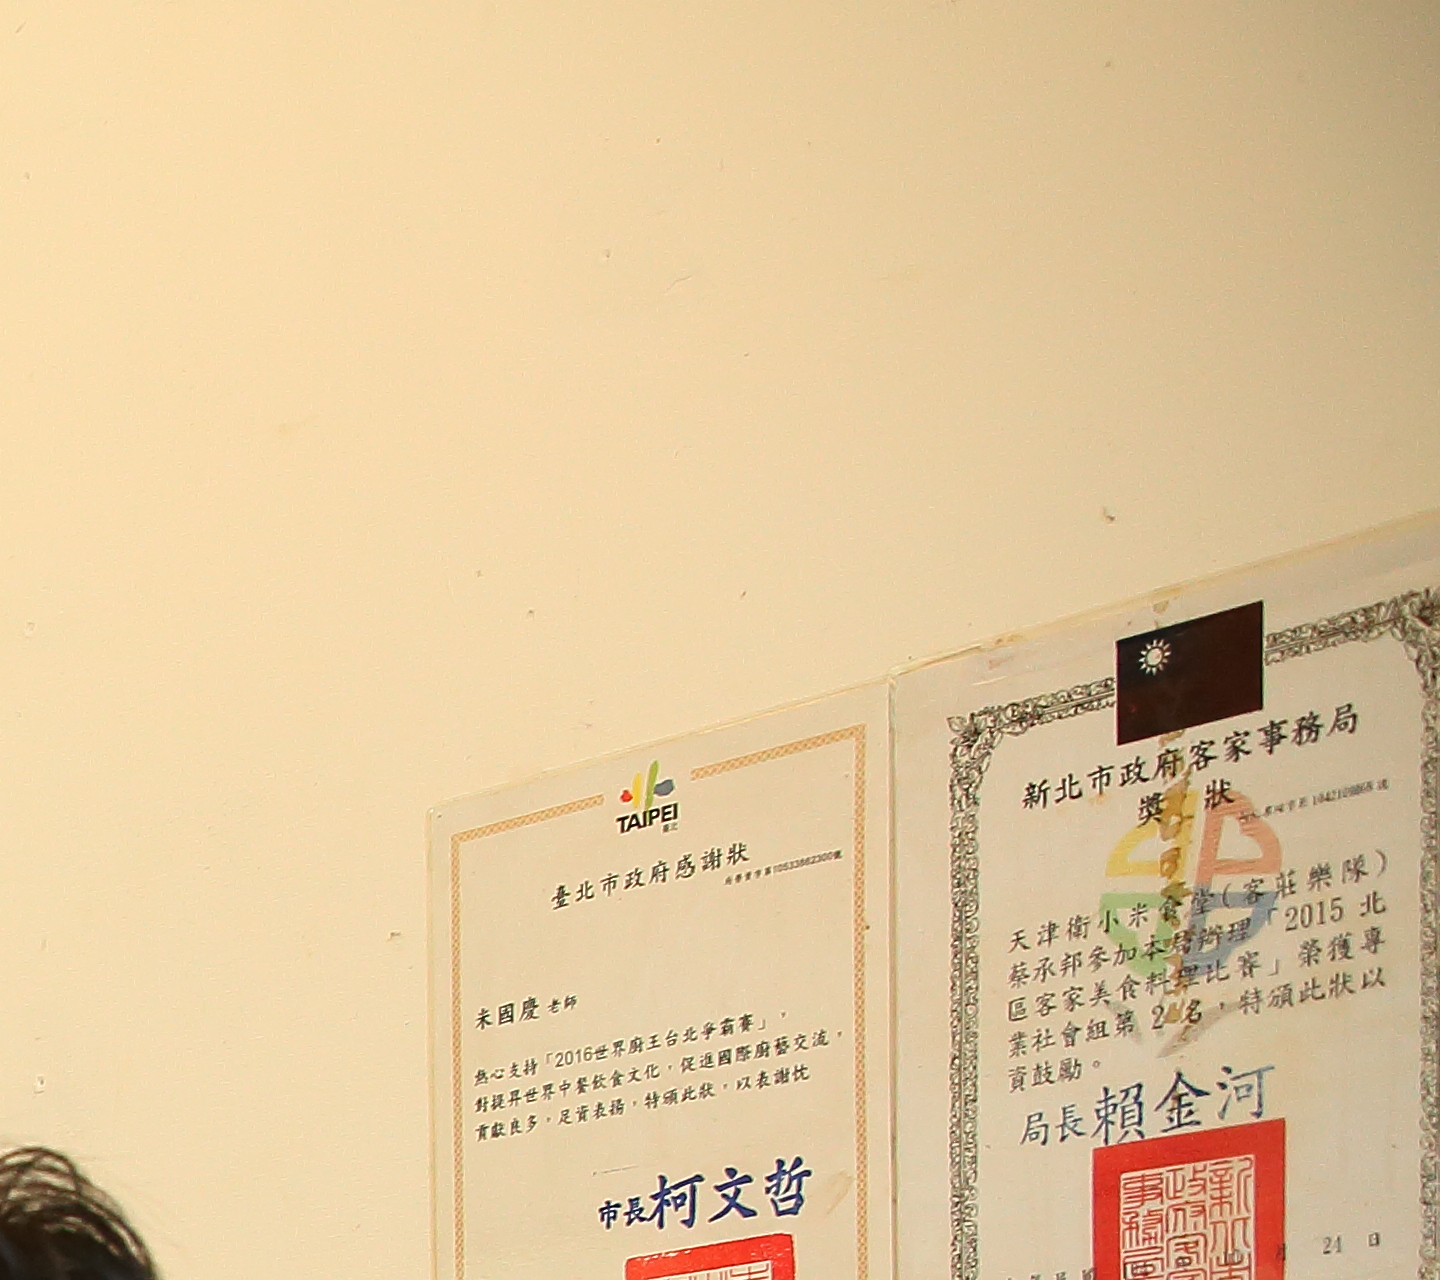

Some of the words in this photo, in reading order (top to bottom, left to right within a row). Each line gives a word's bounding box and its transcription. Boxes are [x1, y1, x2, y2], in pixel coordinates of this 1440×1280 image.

[1022, 703, 1359, 810] 新北市政府客家事務局
[616, 803, 678, 833] TAIPEI
[551, 842, 749, 910] 臺北市政府感謝狀
[547, 994, 578, 1013] 老師
